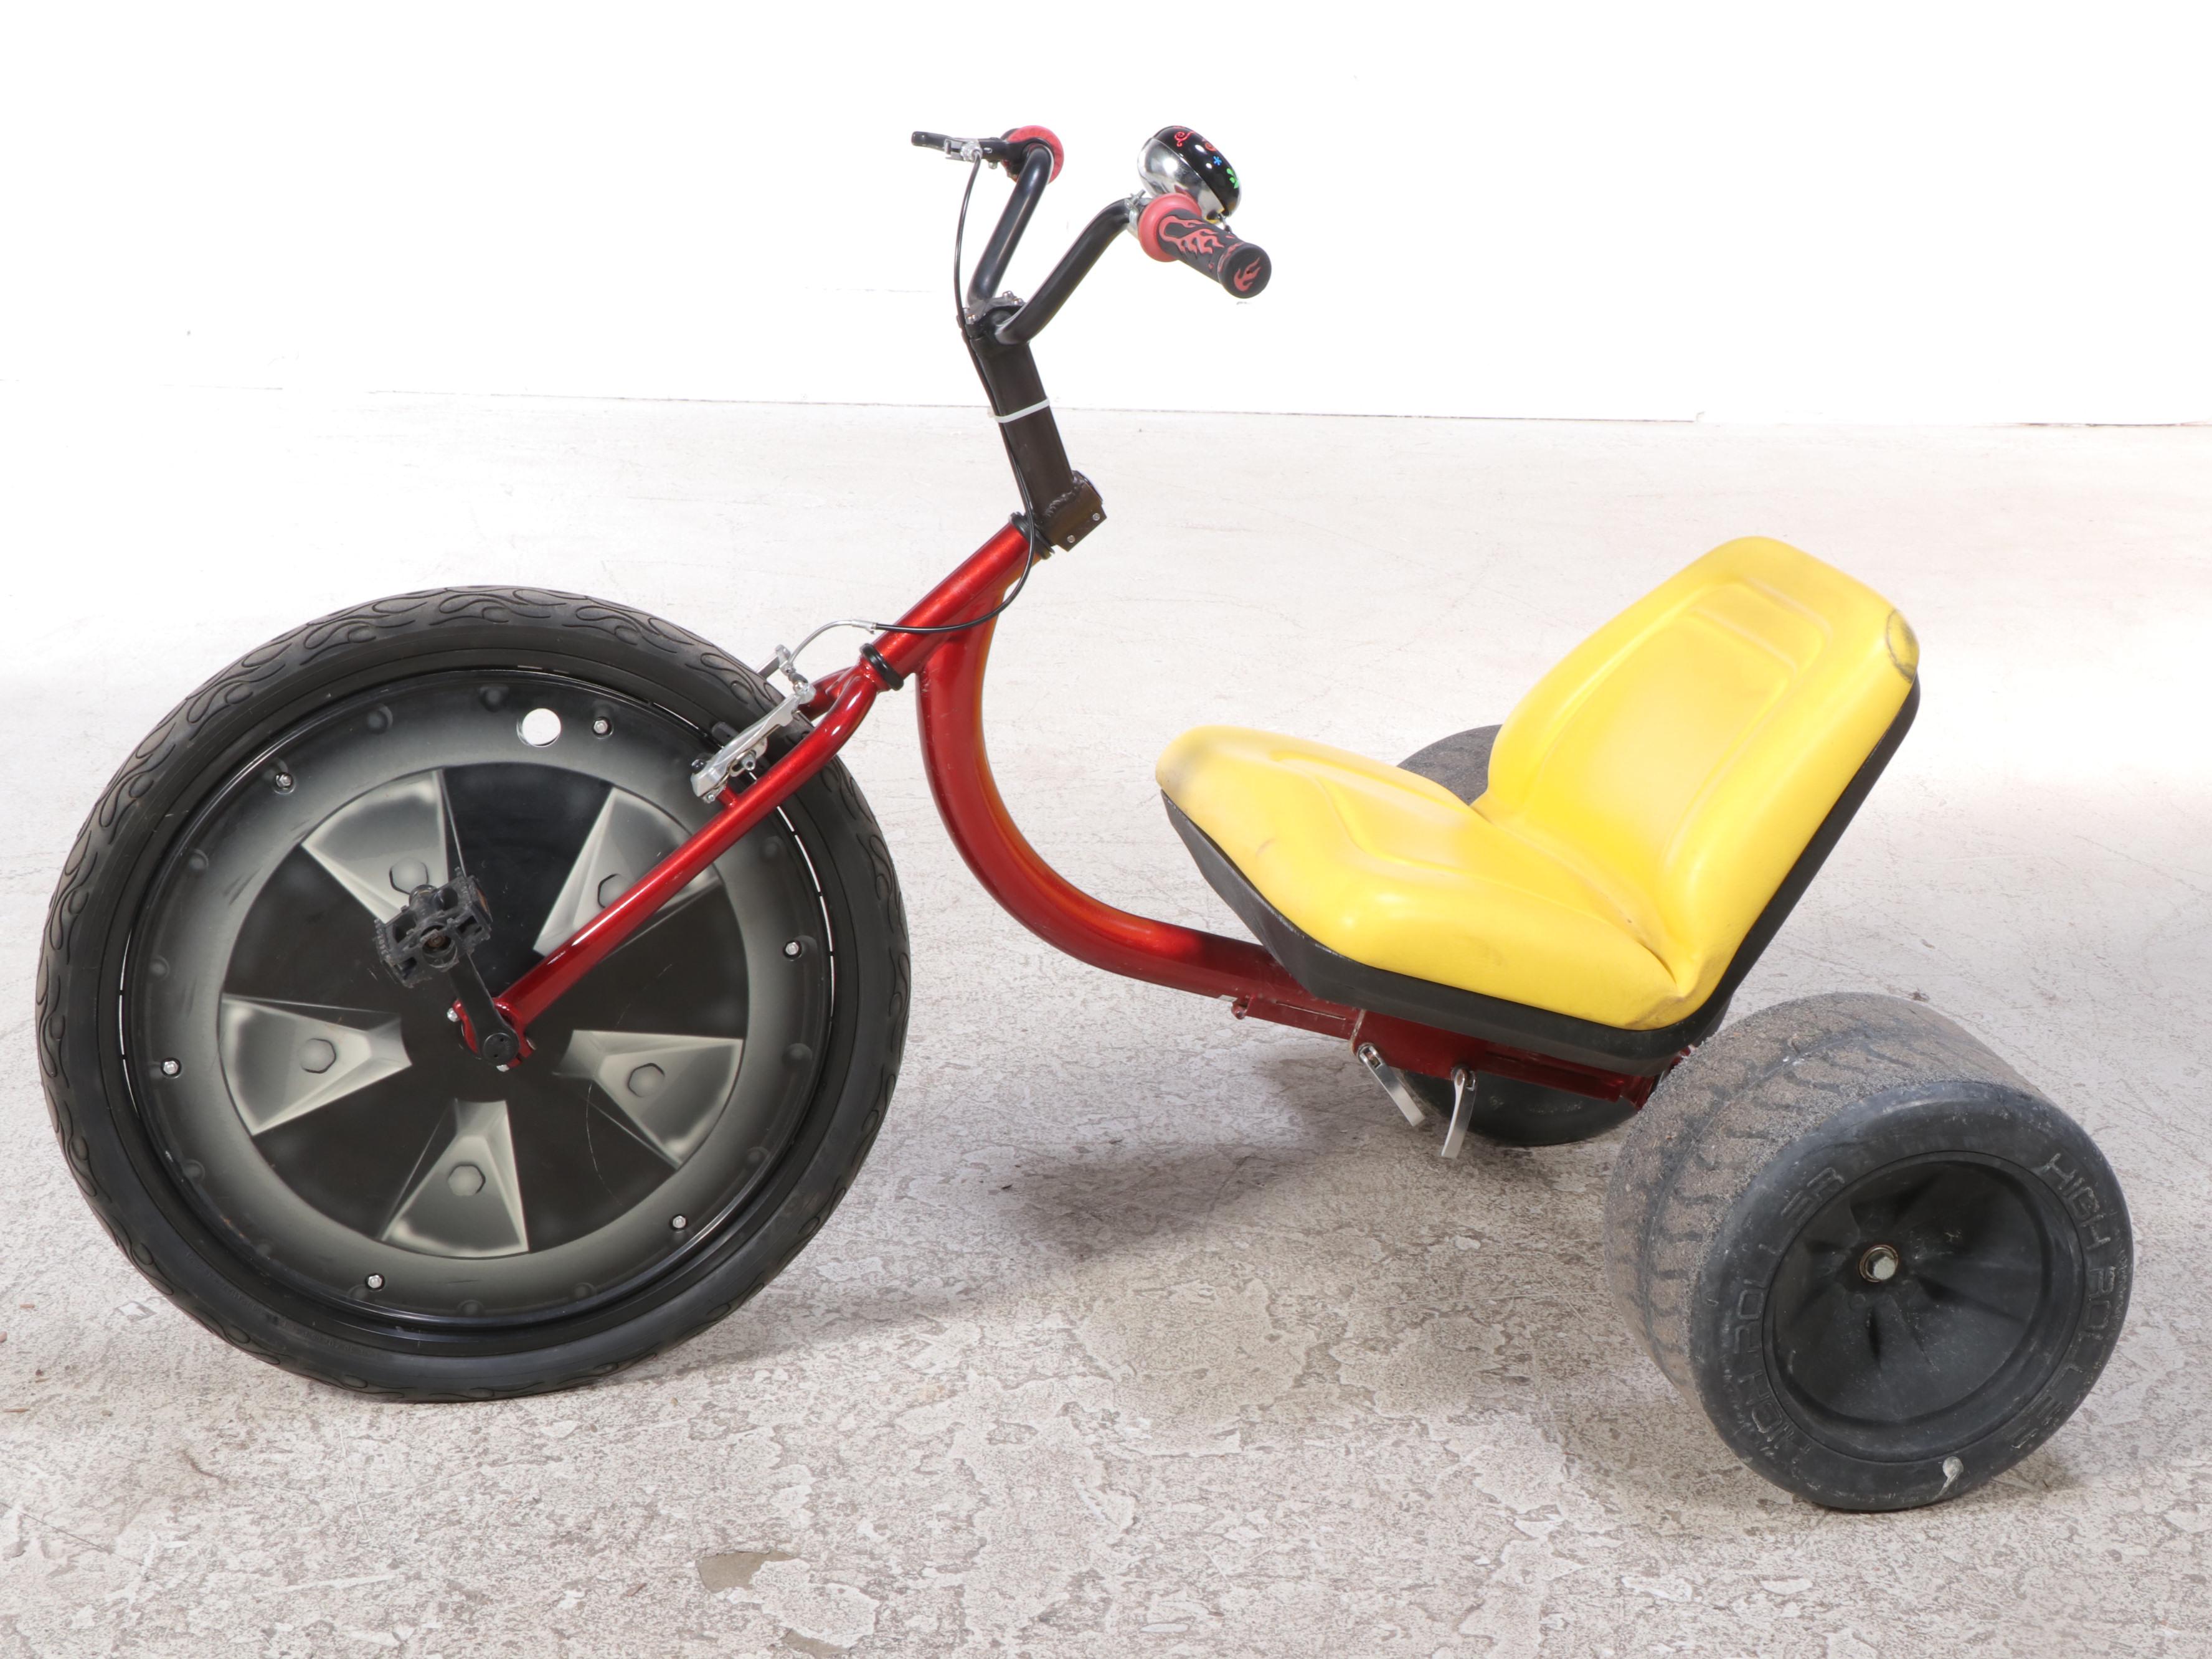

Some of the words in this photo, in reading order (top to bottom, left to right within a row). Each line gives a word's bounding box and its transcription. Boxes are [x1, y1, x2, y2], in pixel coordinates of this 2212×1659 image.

[1734, 1166, 1845, 1355] ROLLER
[2039, 1152, 2112, 1252] HIGH
[2009, 1265, 2116, 1450] ROLLER
